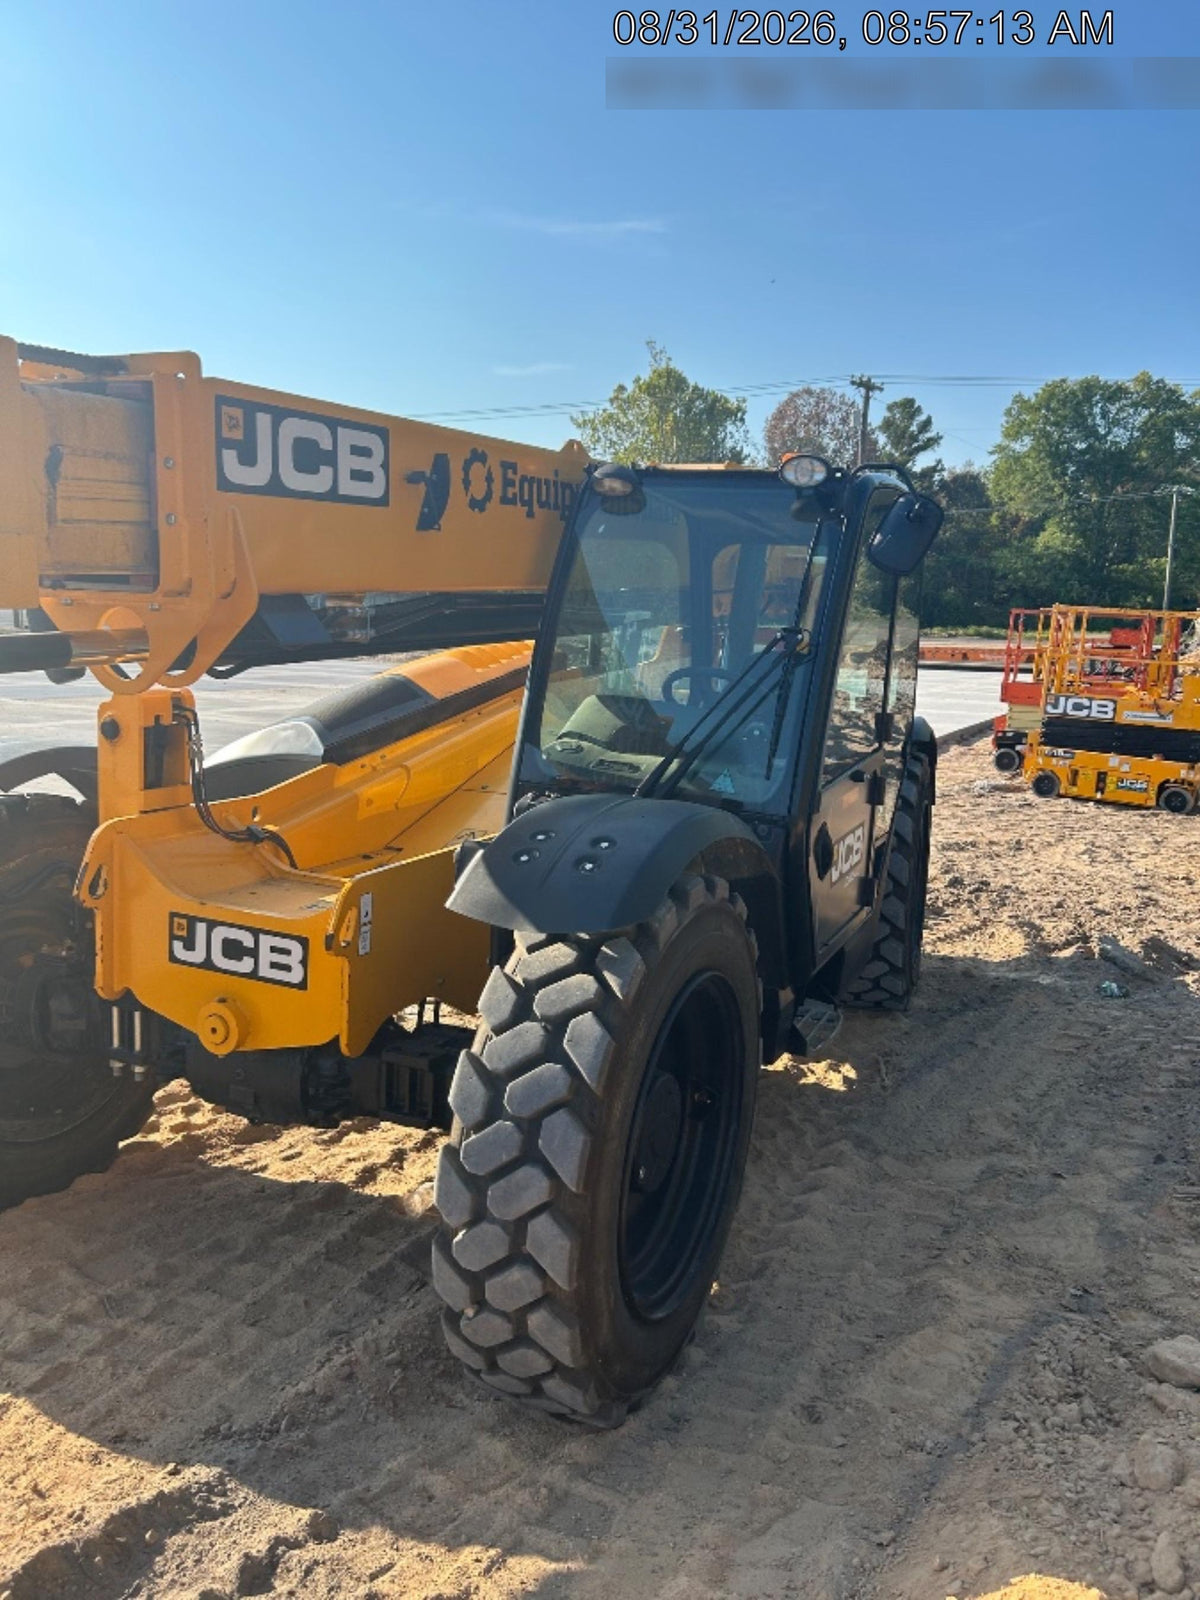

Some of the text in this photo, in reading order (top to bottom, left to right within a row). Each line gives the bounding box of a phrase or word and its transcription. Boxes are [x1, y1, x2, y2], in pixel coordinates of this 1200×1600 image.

[222, 412, 387, 499] JCB
[1045, 696, 1115, 719] JCB
[831, 825, 864, 883] JCB
[172, 921, 305, 984] JCB
